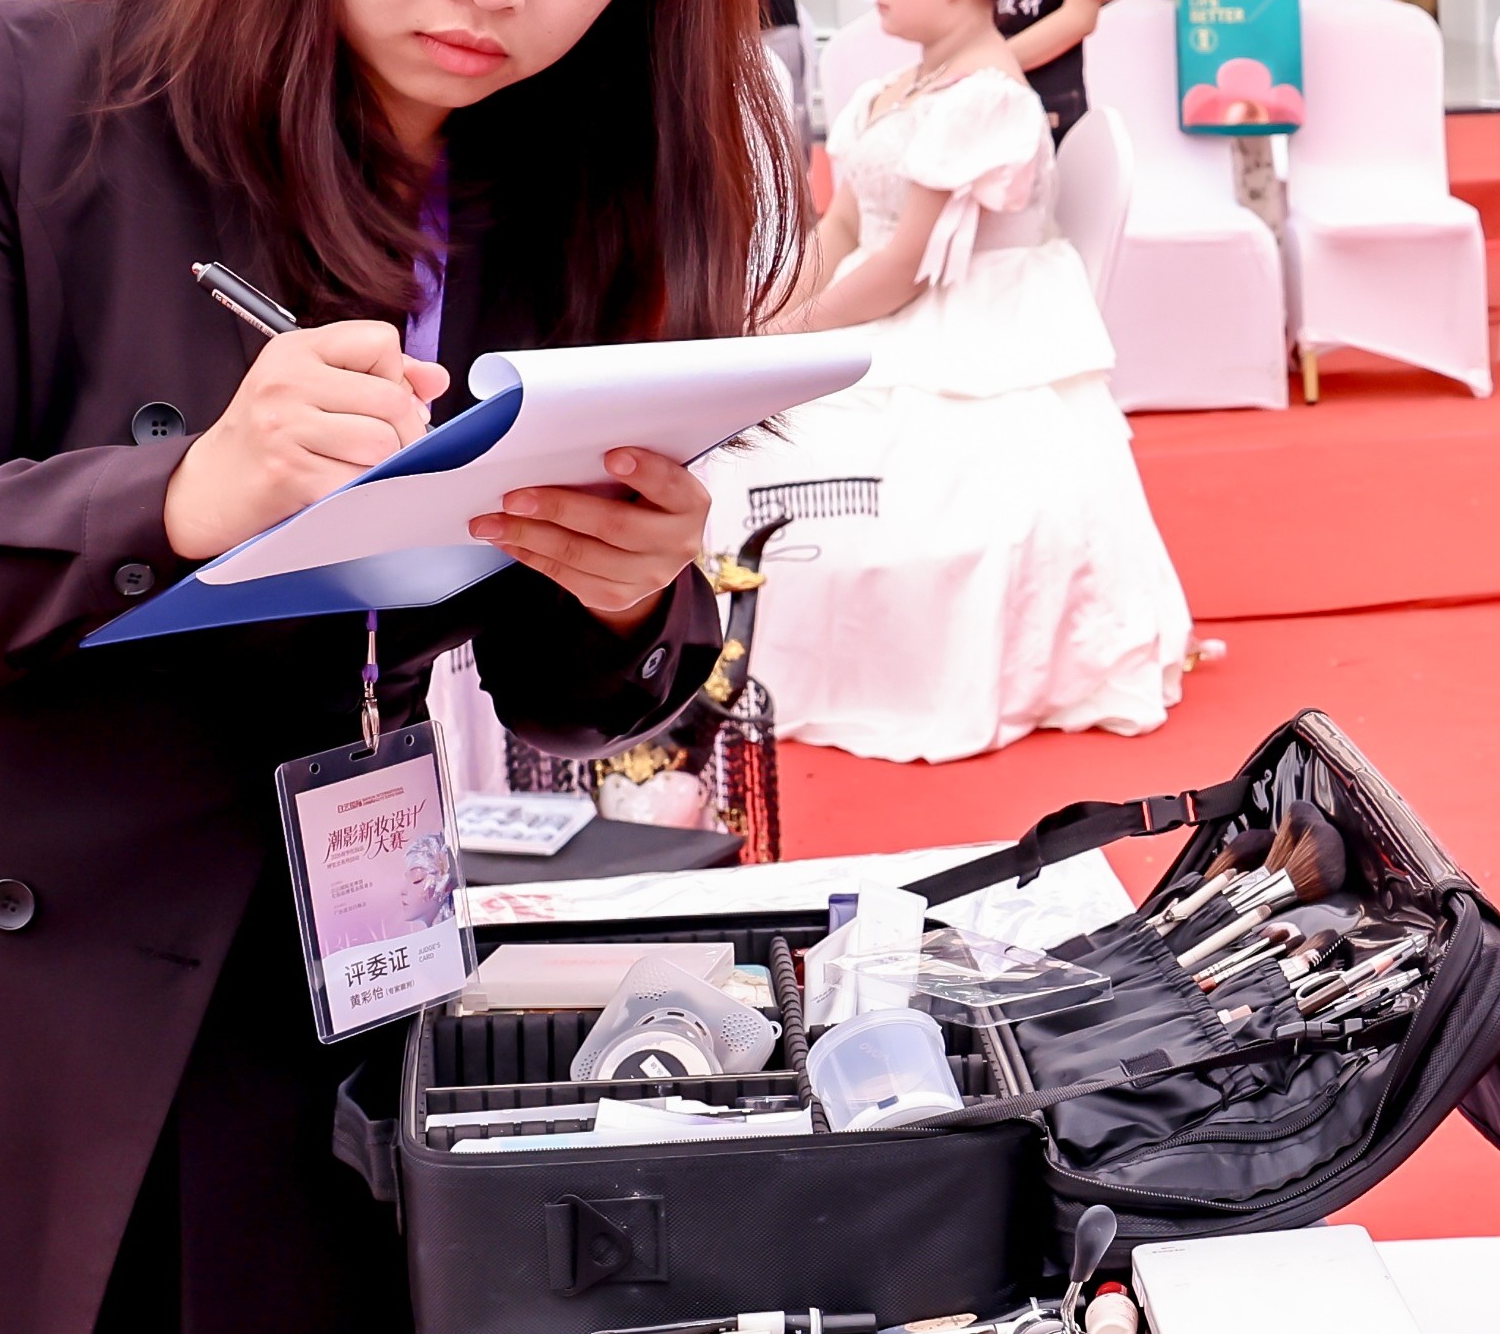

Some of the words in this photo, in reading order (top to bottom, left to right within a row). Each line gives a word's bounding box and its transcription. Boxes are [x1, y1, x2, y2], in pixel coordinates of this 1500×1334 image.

[1189, 7, 1245, 24] BETTER
[323, 797, 428, 865] 潮影新妆设计
[366, 830, 411, 860] 大赛
[417, 941, 442, 956] JUDGE'S
[418, 952, 435, 964] CARD
[344, 946, 412, 989] 评委证
[349, 984, 385, 1010] 黄彩怡
